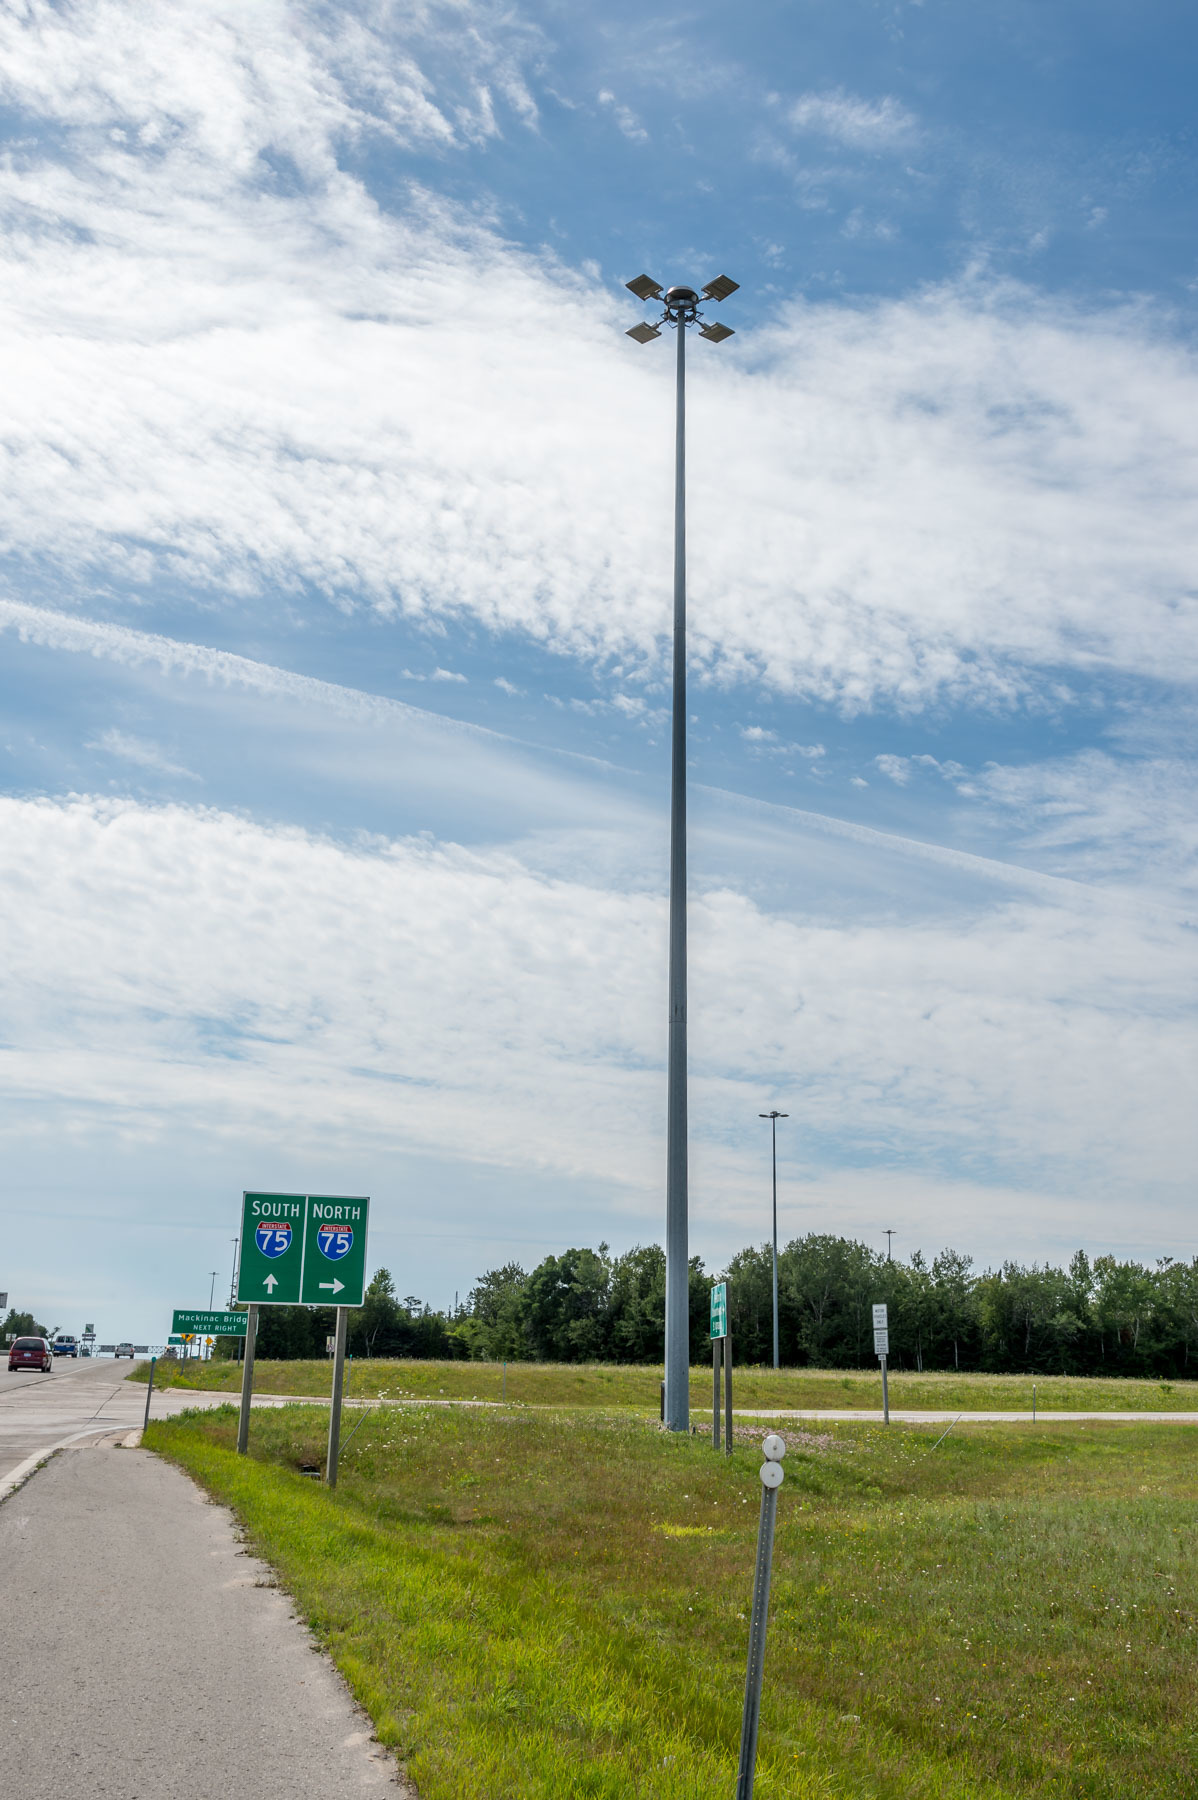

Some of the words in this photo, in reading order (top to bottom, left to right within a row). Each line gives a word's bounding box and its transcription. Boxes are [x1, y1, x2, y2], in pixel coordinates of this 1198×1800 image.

[252, 1201, 300, 1217] SOUTH
[313, 1203, 361, 1220] NORTH
[259, 1230, 288, 1252] 75
[321, 1233, 350, 1254] 75
[178, 1314, 219, 1322] Mackinac
[223, 1315, 247, 1325] Bridg
